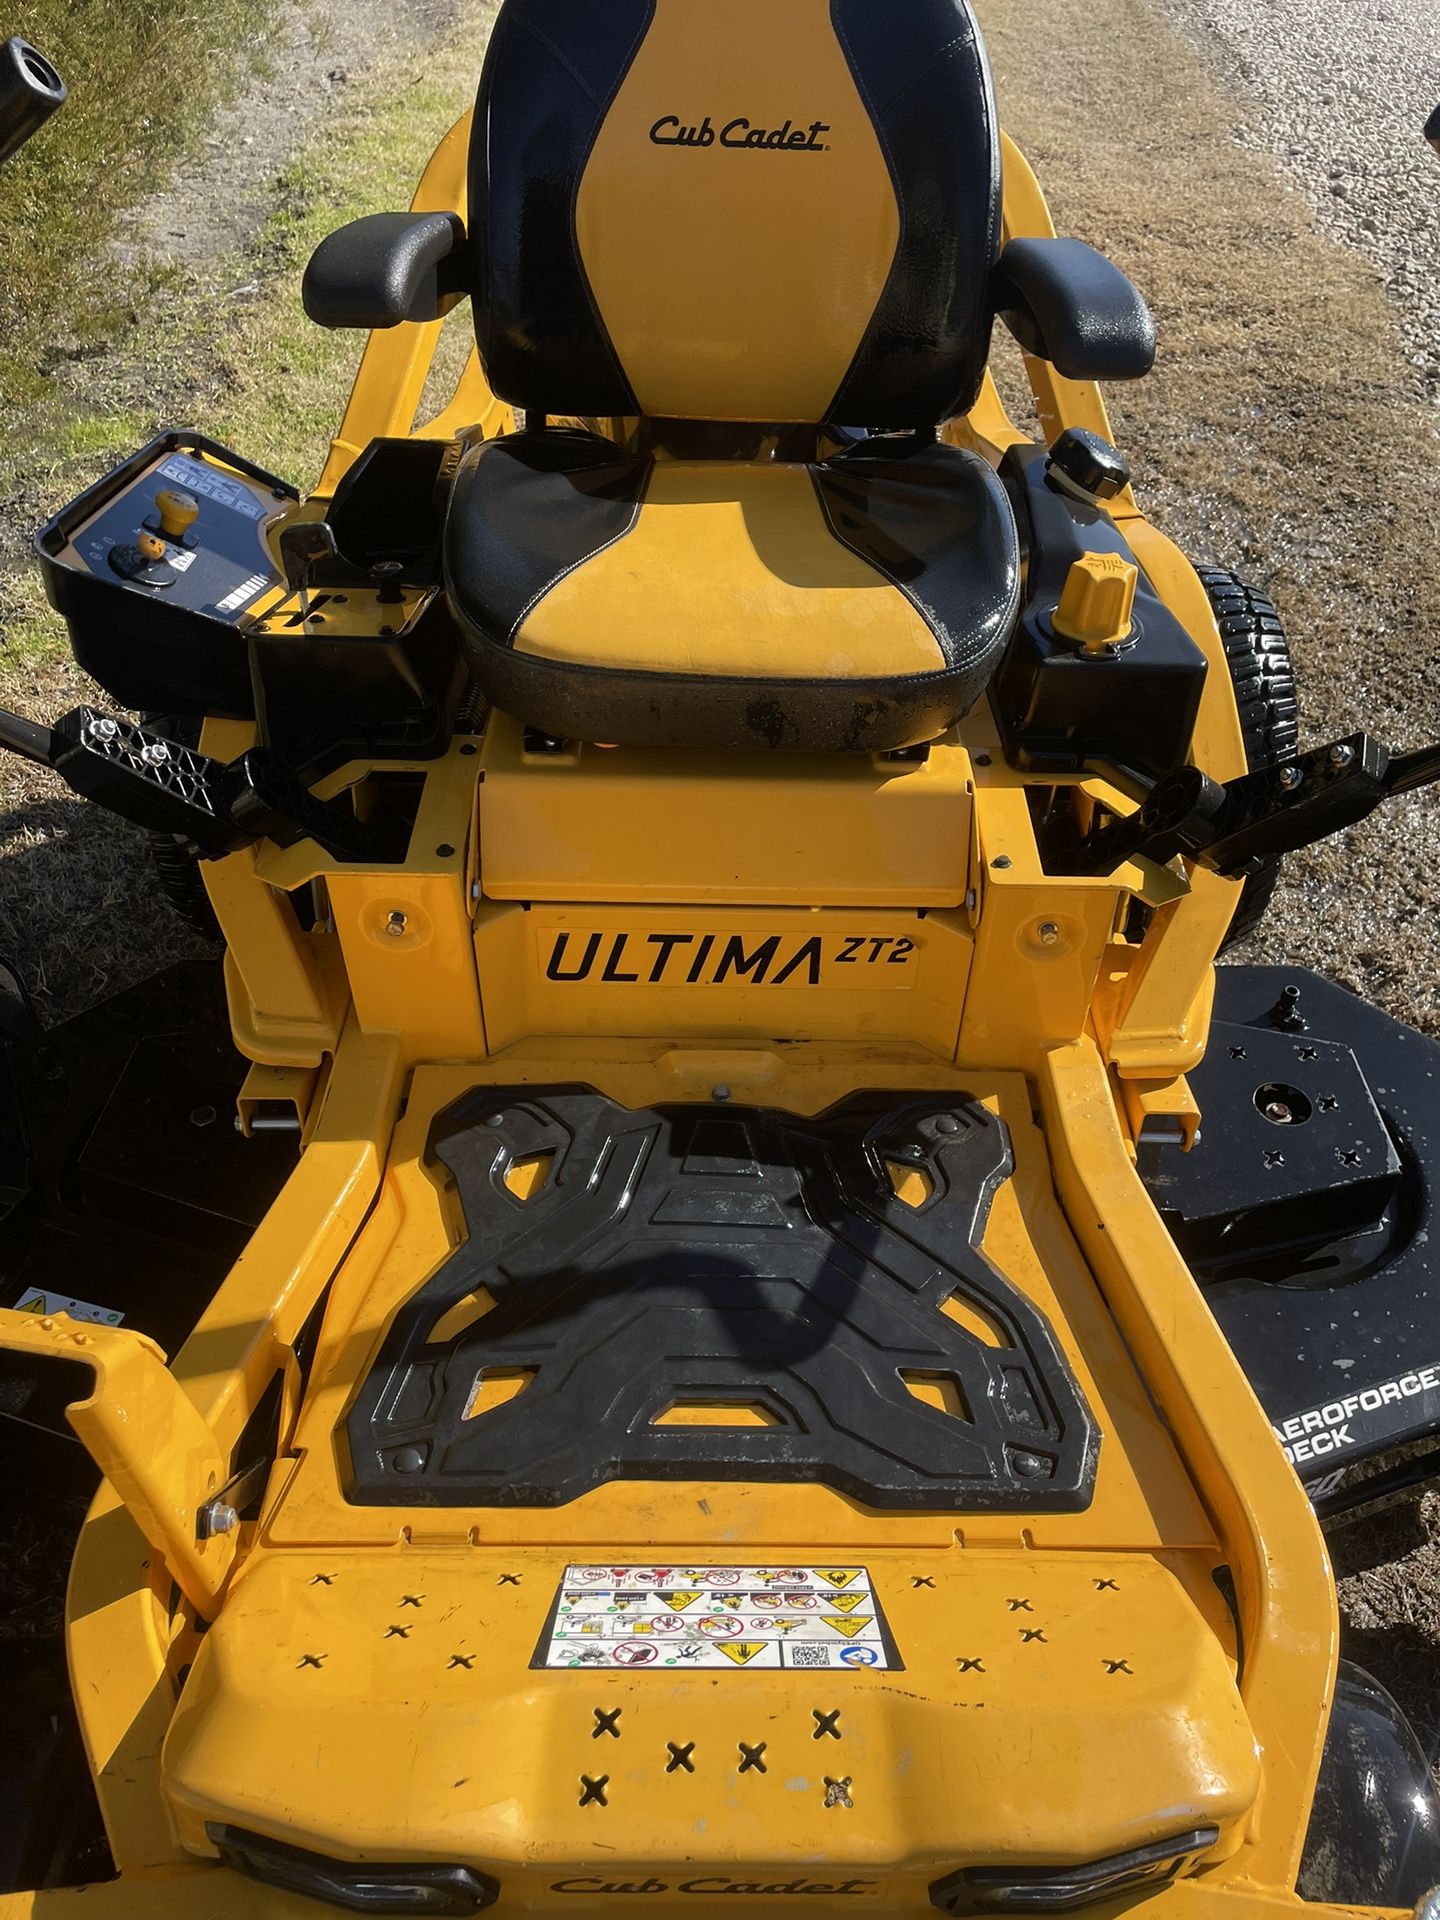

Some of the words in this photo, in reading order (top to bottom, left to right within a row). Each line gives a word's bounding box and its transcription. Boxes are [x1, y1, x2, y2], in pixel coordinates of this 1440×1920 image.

[650, 115, 714, 147] Cub
[720, 118, 829, 151] Cadet
[545, 932, 822, 984] ULTIMA
[834, 936, 914, 964] ZT2
[550, 1876, 668, 1894] Cub
[678, 1877, 878, 1895] Cadet
